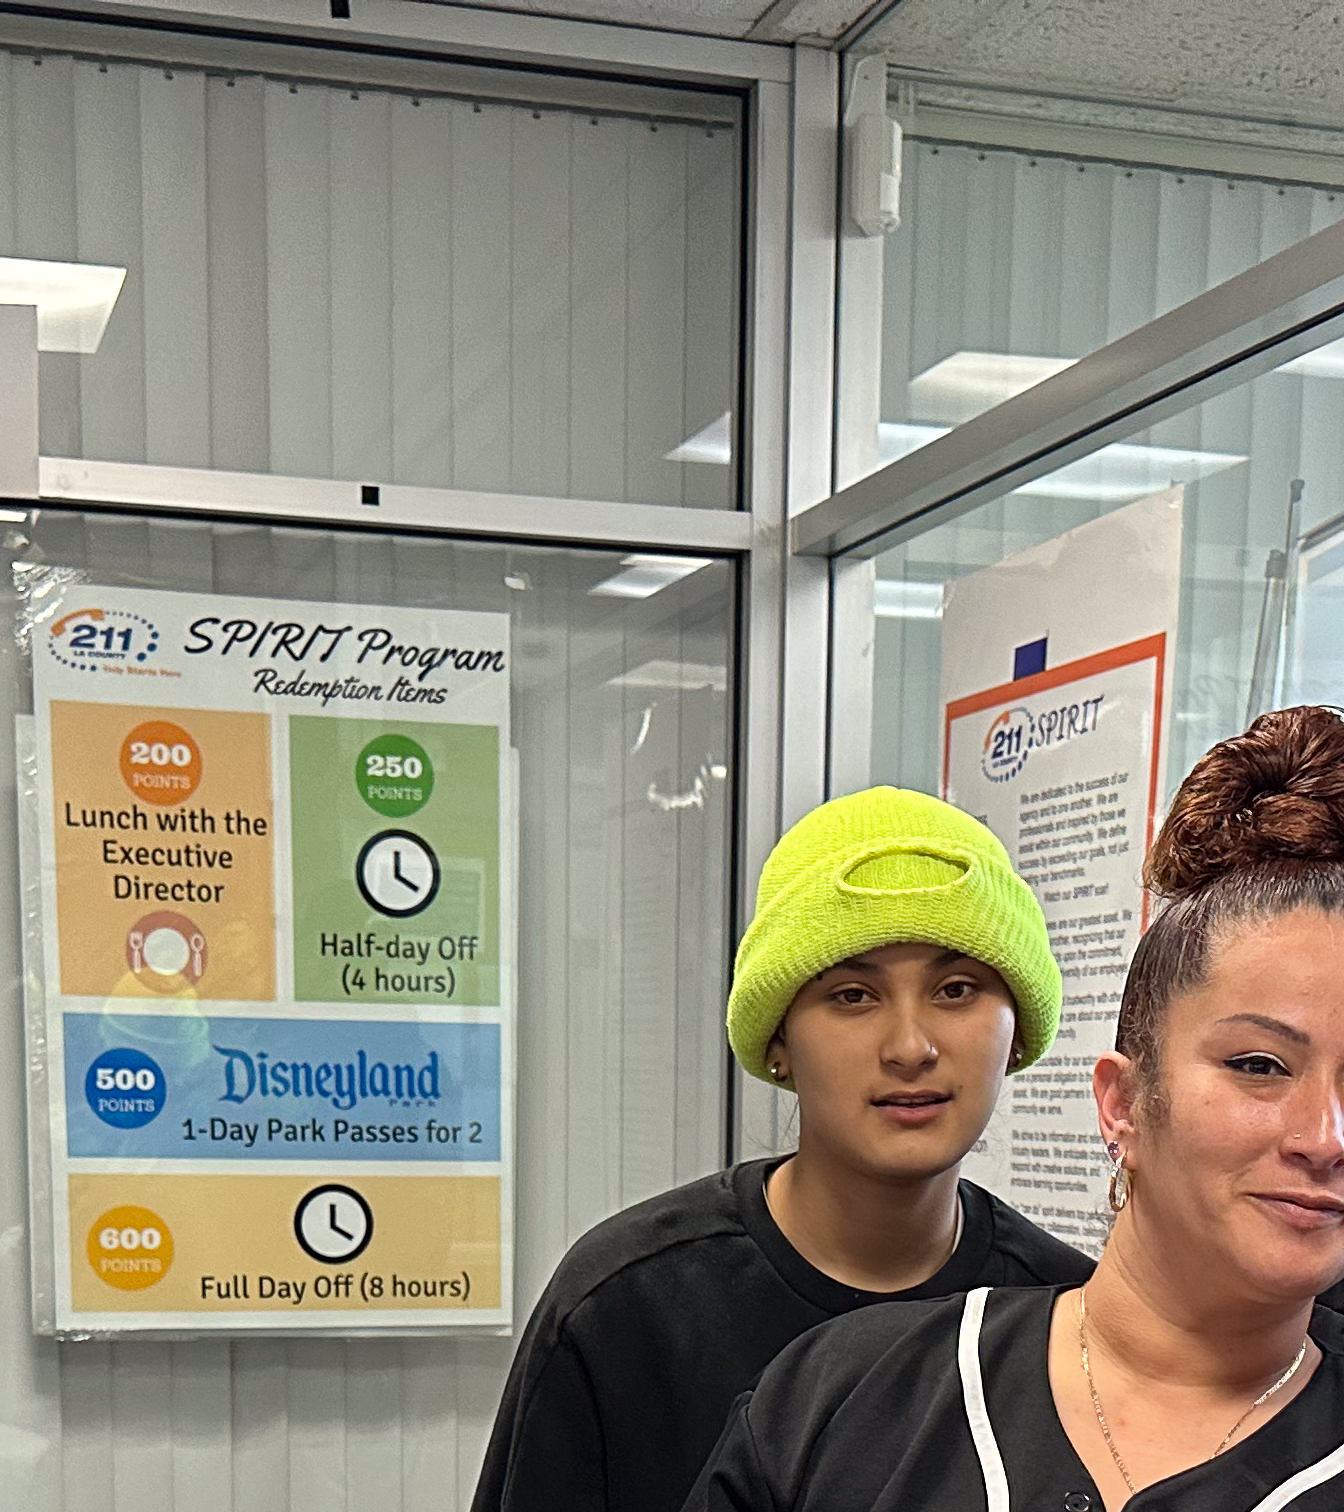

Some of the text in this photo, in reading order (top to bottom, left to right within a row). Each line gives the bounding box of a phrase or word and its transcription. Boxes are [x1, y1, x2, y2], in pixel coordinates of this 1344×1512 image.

[69, 623, 133, 652] 211
[183, 616, 506, 682] SPIRIT Program
[253, 668, 448, 707] Redemption Items
[1035, 693, 1106, 748] SPIRIT
[128, 741, 192, 767] 200
[991, 724, 1023, 759] 211
[132, 772, 192, 790] POINTS
[365, 754, 423, 779] 250
[367, 785, 423, 801] POINTS
[64, 802, 268, 837] Lunch with the
[102, 839, 234, 870] Executive
[113, 875, 225, 903] Director
[320, 933, 479, 966] Half-day Off
[341, 967, 457, 997] (4 hours)
[95, 1067, 156, 1092] 500
[212, 1044, 441, 1110] Disneyland
[98, 1098, 155, 1113] POINTS
[182, 1117, 483, 1148] 1-Day Park Passes for 2
[98, 1226, 162, 1251] 600
[201, 1271, 472, 1305] Full Day Off (8 hours)
